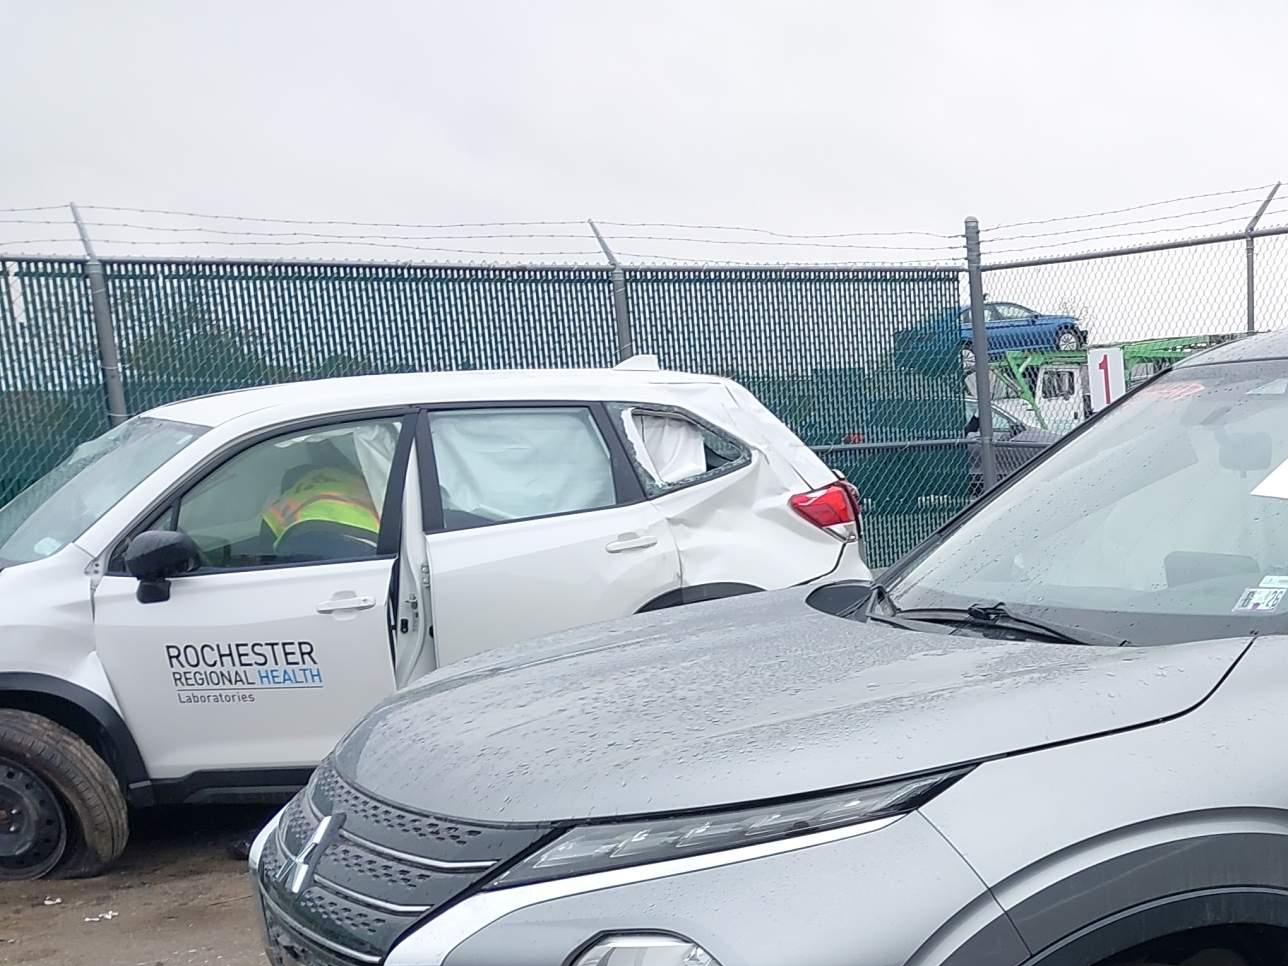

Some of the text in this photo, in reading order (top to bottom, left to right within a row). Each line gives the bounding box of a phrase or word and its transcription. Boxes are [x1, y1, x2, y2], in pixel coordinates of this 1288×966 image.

[1098, 354, 1111, 405] 1
[165, 641, 318, 669] ROCHESTER
[172, 668, 323, 687] REGIONAL HEALTH
[177, 692, 256, 704] Laboratories
